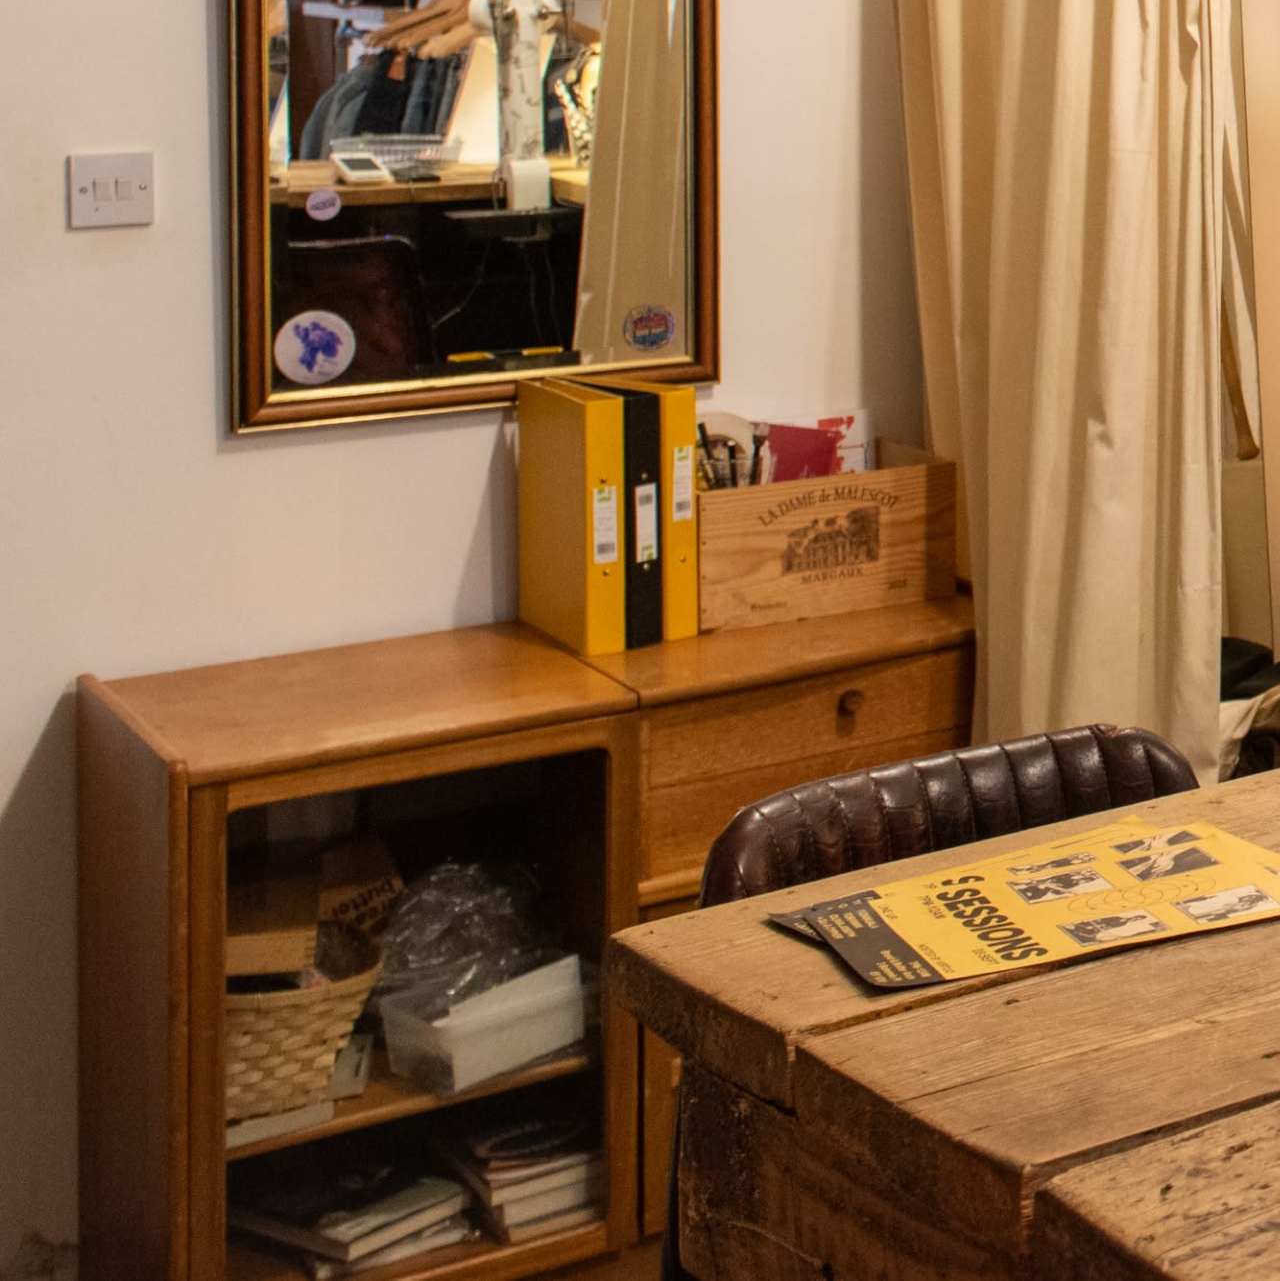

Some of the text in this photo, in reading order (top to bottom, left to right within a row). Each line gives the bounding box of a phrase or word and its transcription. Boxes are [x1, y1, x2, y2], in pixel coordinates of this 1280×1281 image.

[758, 486, 900, 527] LA DAME de MALESCOT
[801, 568, 864, 584] MARGAUX
[936, 888, 1049, 962] SESSIONS
